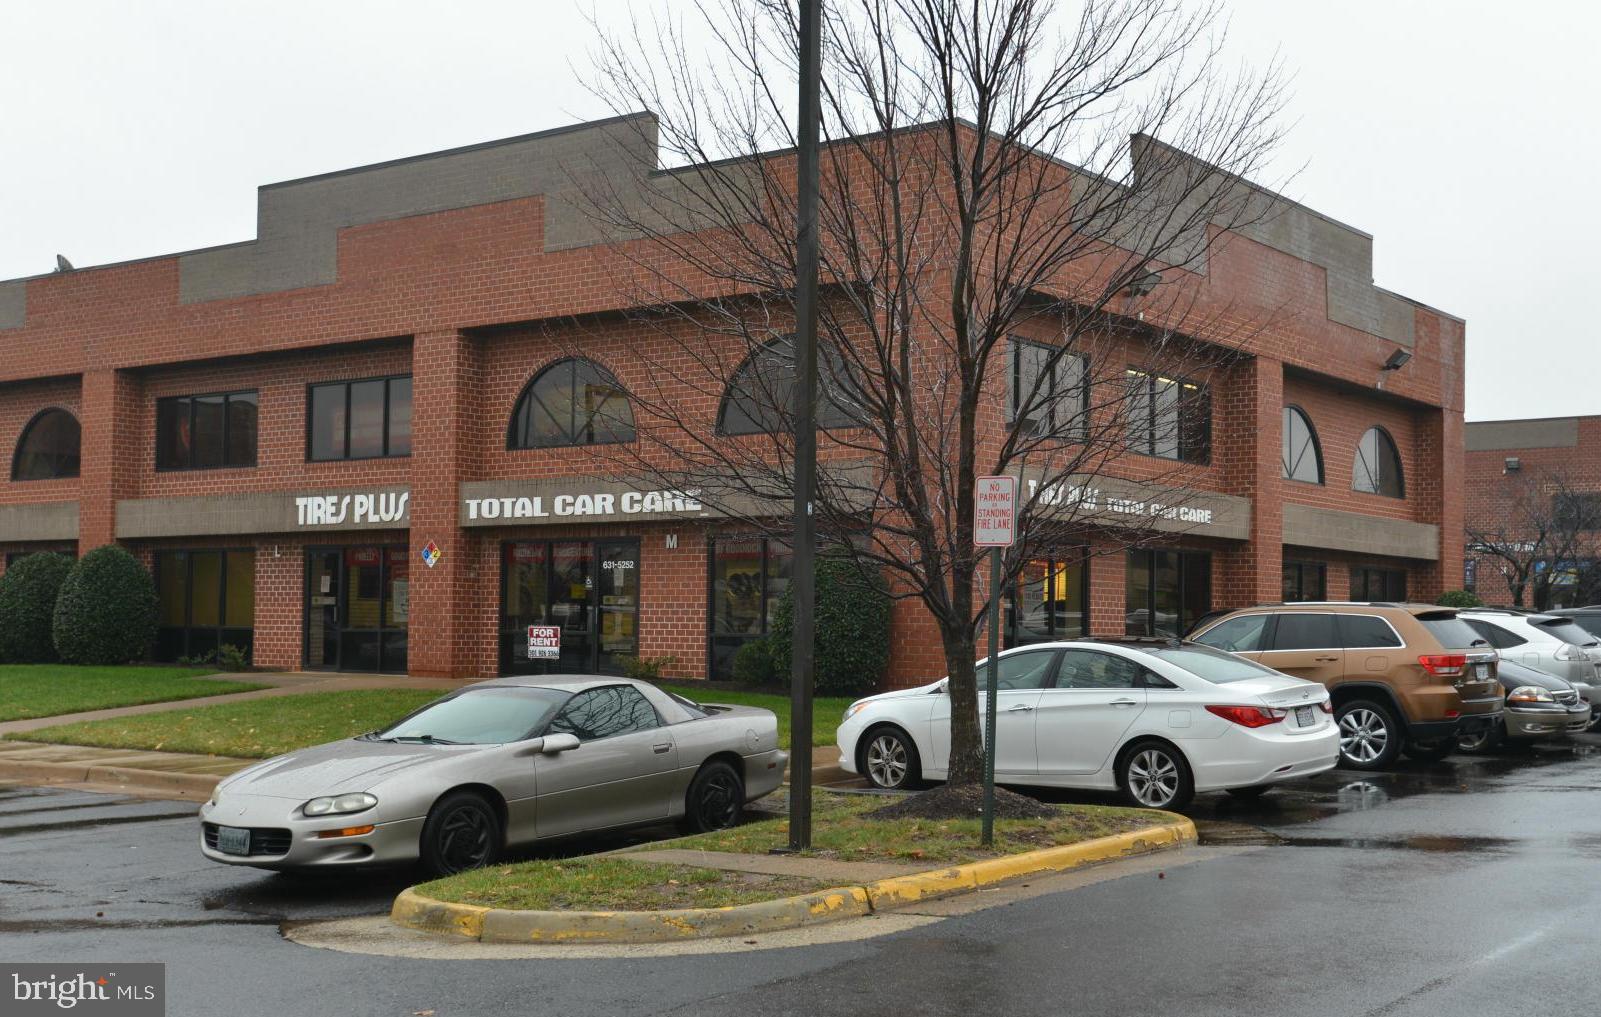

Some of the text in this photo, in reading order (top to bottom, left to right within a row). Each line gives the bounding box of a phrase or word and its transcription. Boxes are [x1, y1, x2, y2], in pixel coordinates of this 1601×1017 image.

[990, 483, 1000, 492] NO
[979, 493, 1010, 502] PARKING
[296, 491, 409, 525] TIRES PLUS
[465, 490, 702, 519] TOTAL CAR CARE
[978, 509, 1011, 518] STANDING
[1179, 506, 1212, 524] CARE
[977, 519, 1010, 530] FIRE LANE
[666, 534, 678, 549] M
[275, 544, 281, 558] L
[603, 560, 634, 569] 631-5252
[533, 628, 554, 638] FOR
[530, 637, 558, 647] RENT
